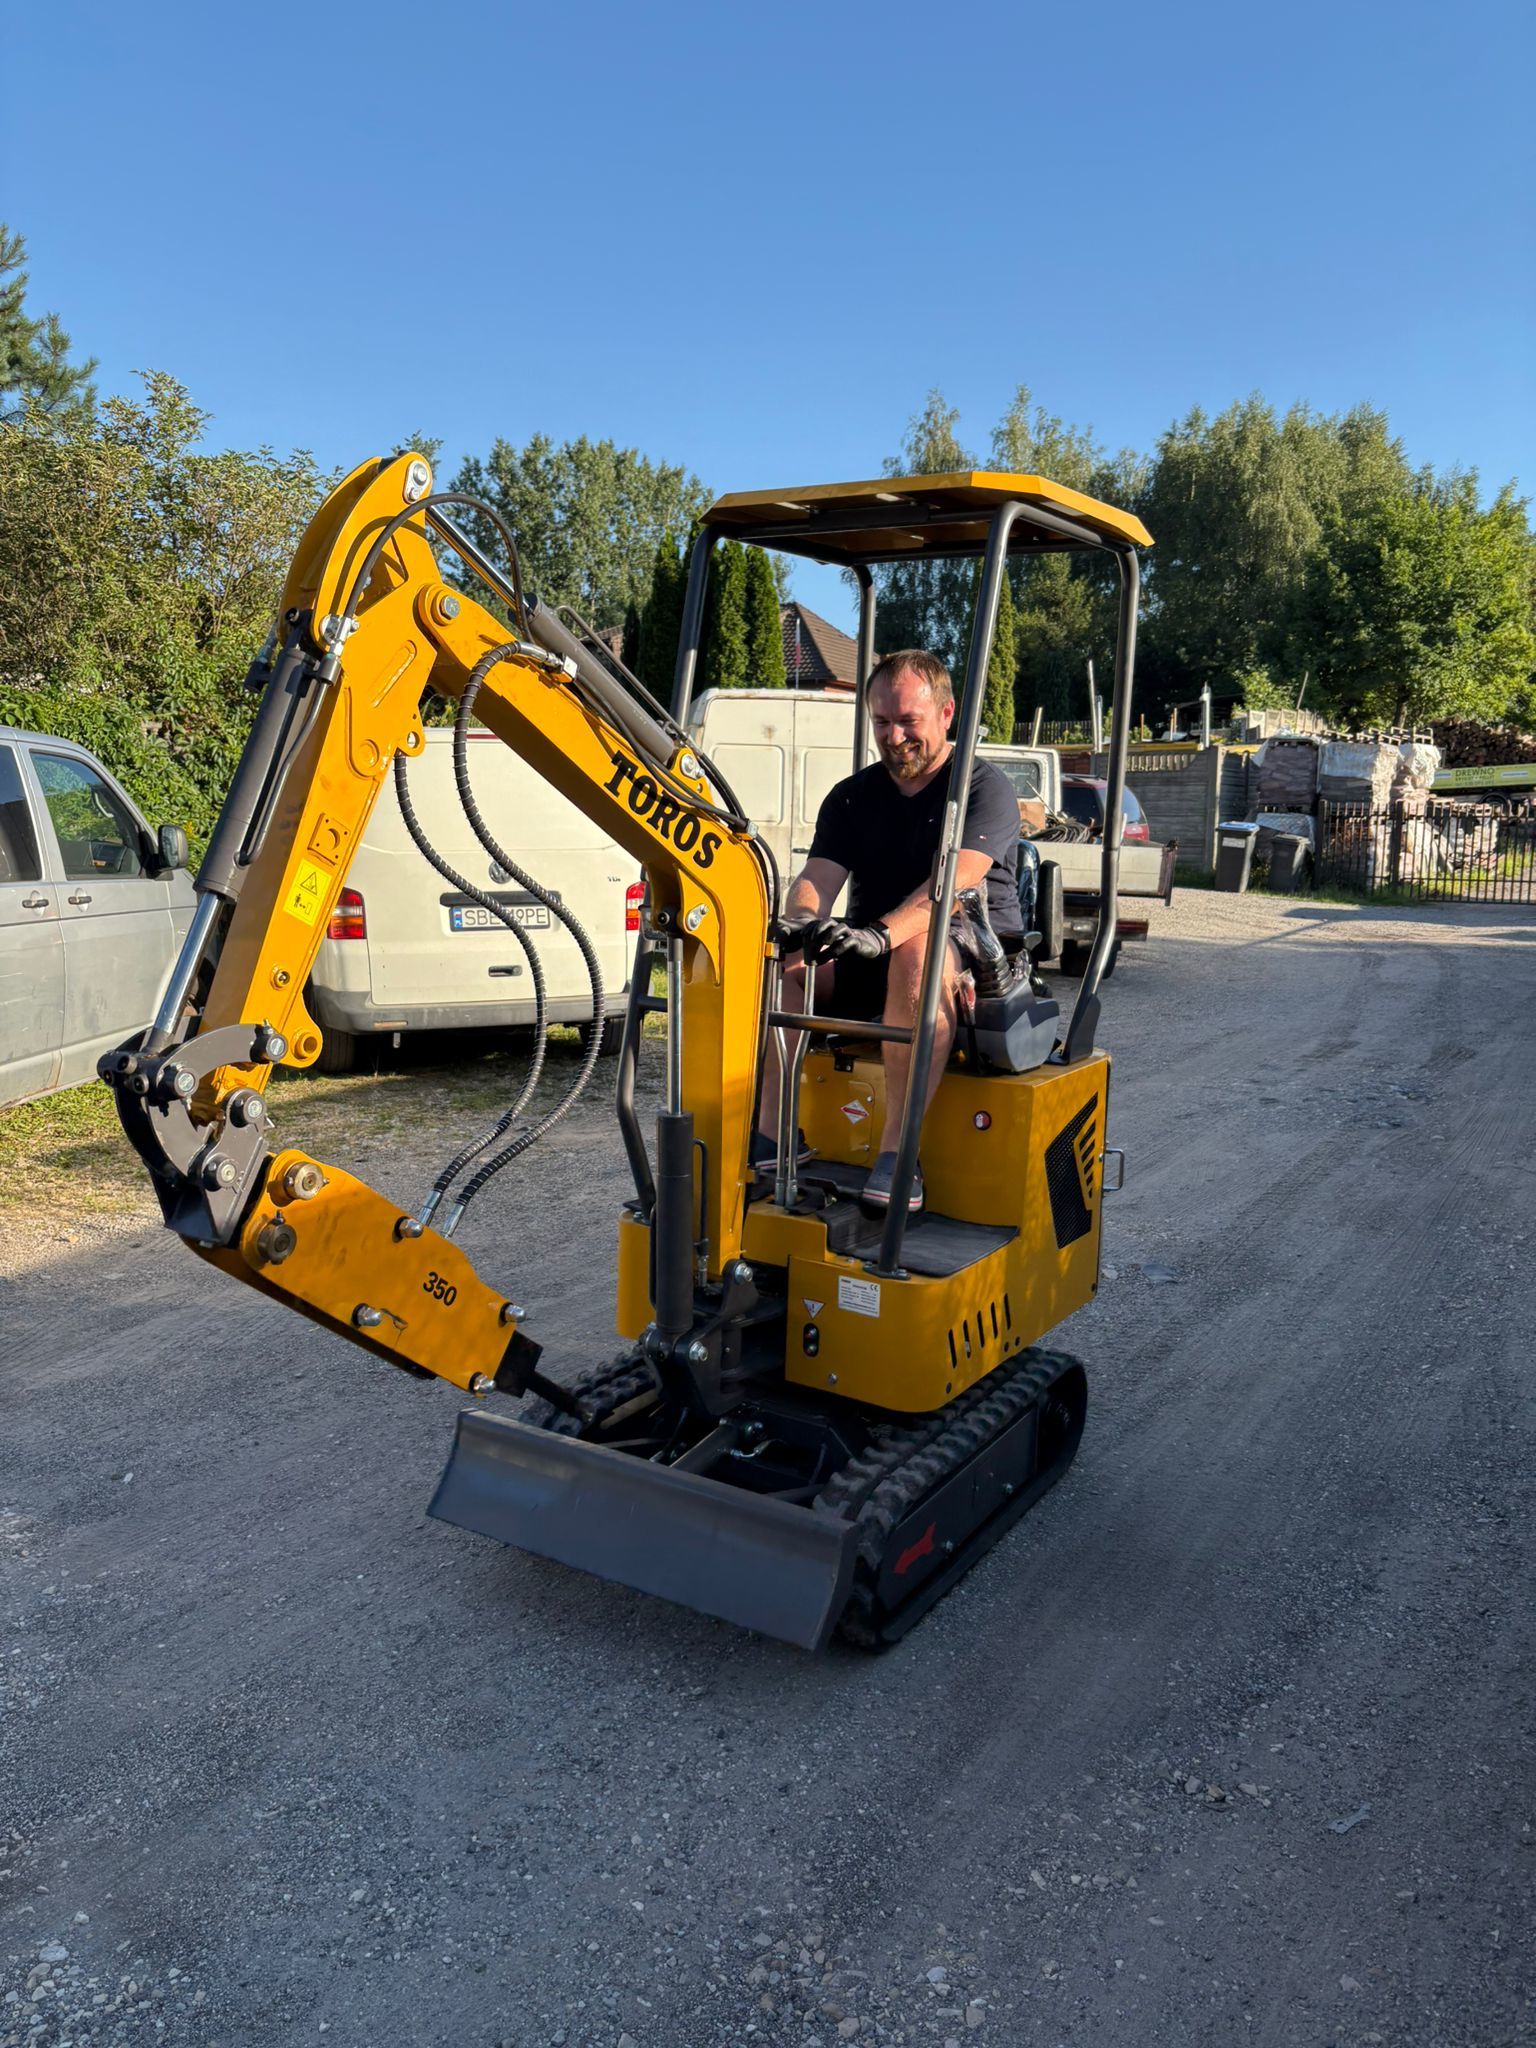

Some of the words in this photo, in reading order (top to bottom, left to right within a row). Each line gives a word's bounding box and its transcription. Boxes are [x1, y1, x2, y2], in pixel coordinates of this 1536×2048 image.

[1455, 767, 1495, 777] DREWNO
[603, 750, 723, 869] TOROS
[423, 1271, 457, 1306] 350
